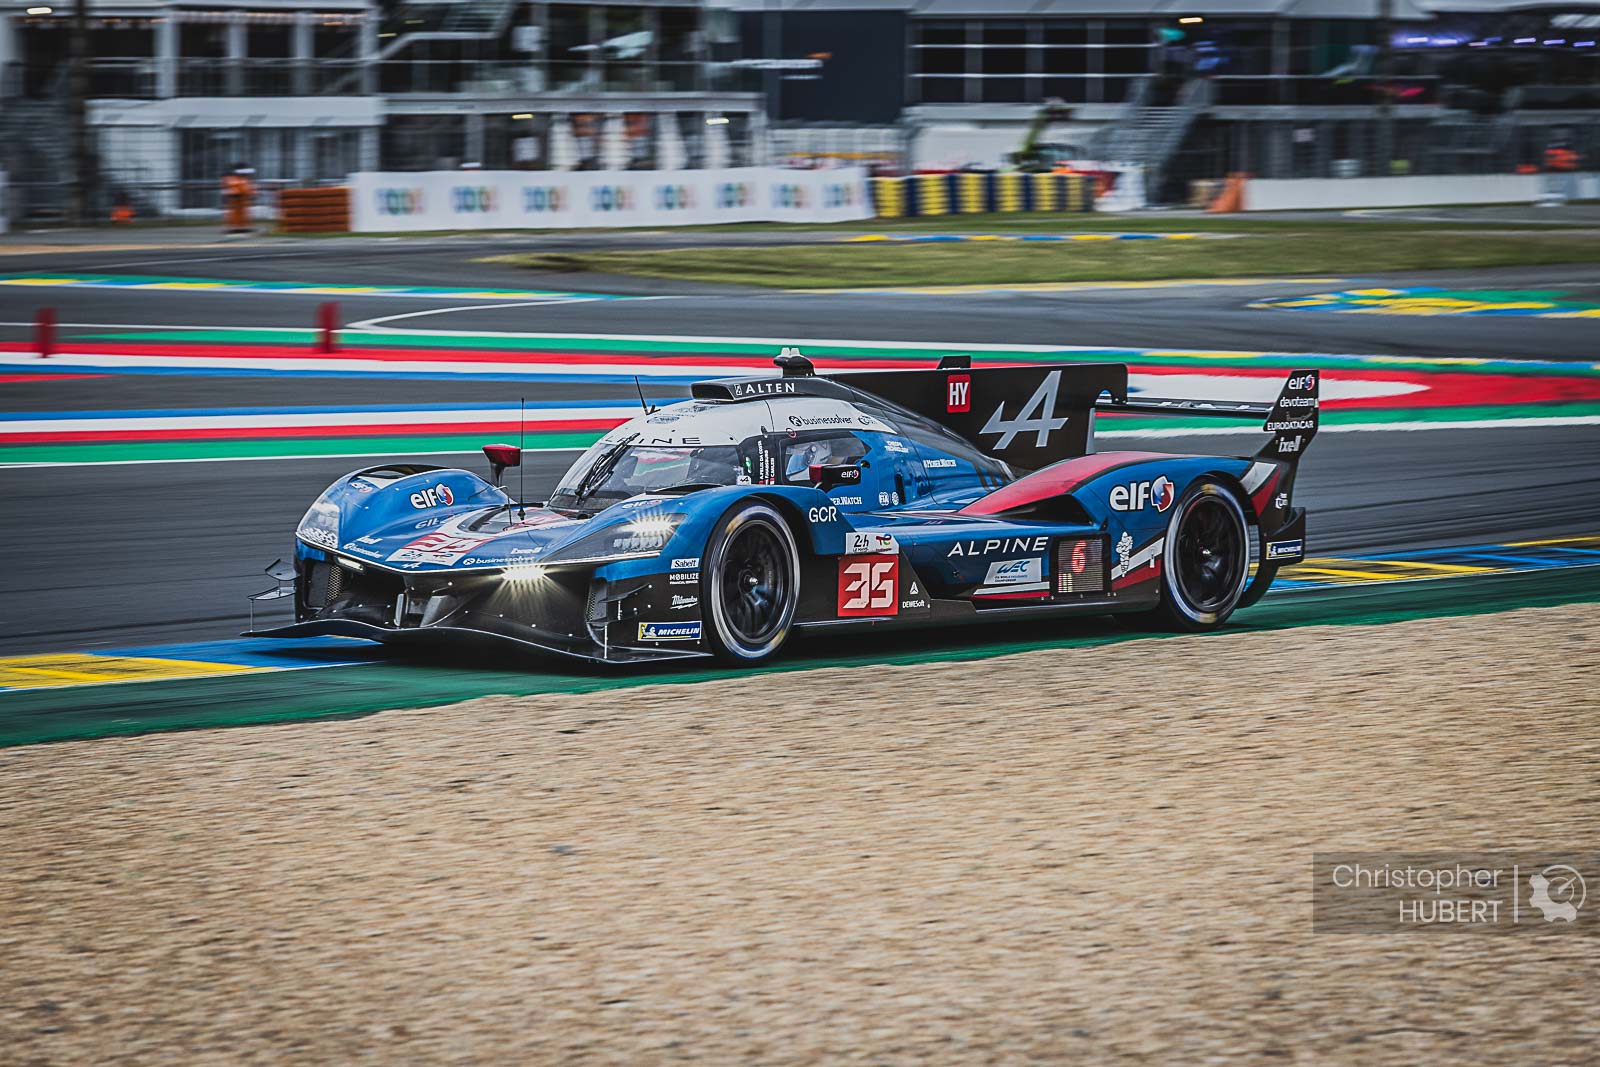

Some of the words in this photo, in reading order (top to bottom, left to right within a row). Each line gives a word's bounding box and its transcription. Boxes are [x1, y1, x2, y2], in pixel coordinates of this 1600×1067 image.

[745, 382, 795, 394] ALTEN
[1288, 377, 1305, 390] elf
[949, 382, 969, 406] HY
[1280, 397, 1314, 408] devoteam
[800, 414, 852, 425] businessolver
[1267, 420, 1314, 431] EURODATACAR
[1278, 436, 1302, 453] ixell
[410, 487, 437, 509] elf
[1109, 481, 1149, 511] elf
[809, 506, 837, 523] GCR
[947, 536, 1049, 558] ALPINE
[997, 560, 1031, 574] WEC
[842, 562, 894, 609] 35
[657, 627, 700, 636] MICHELIN
